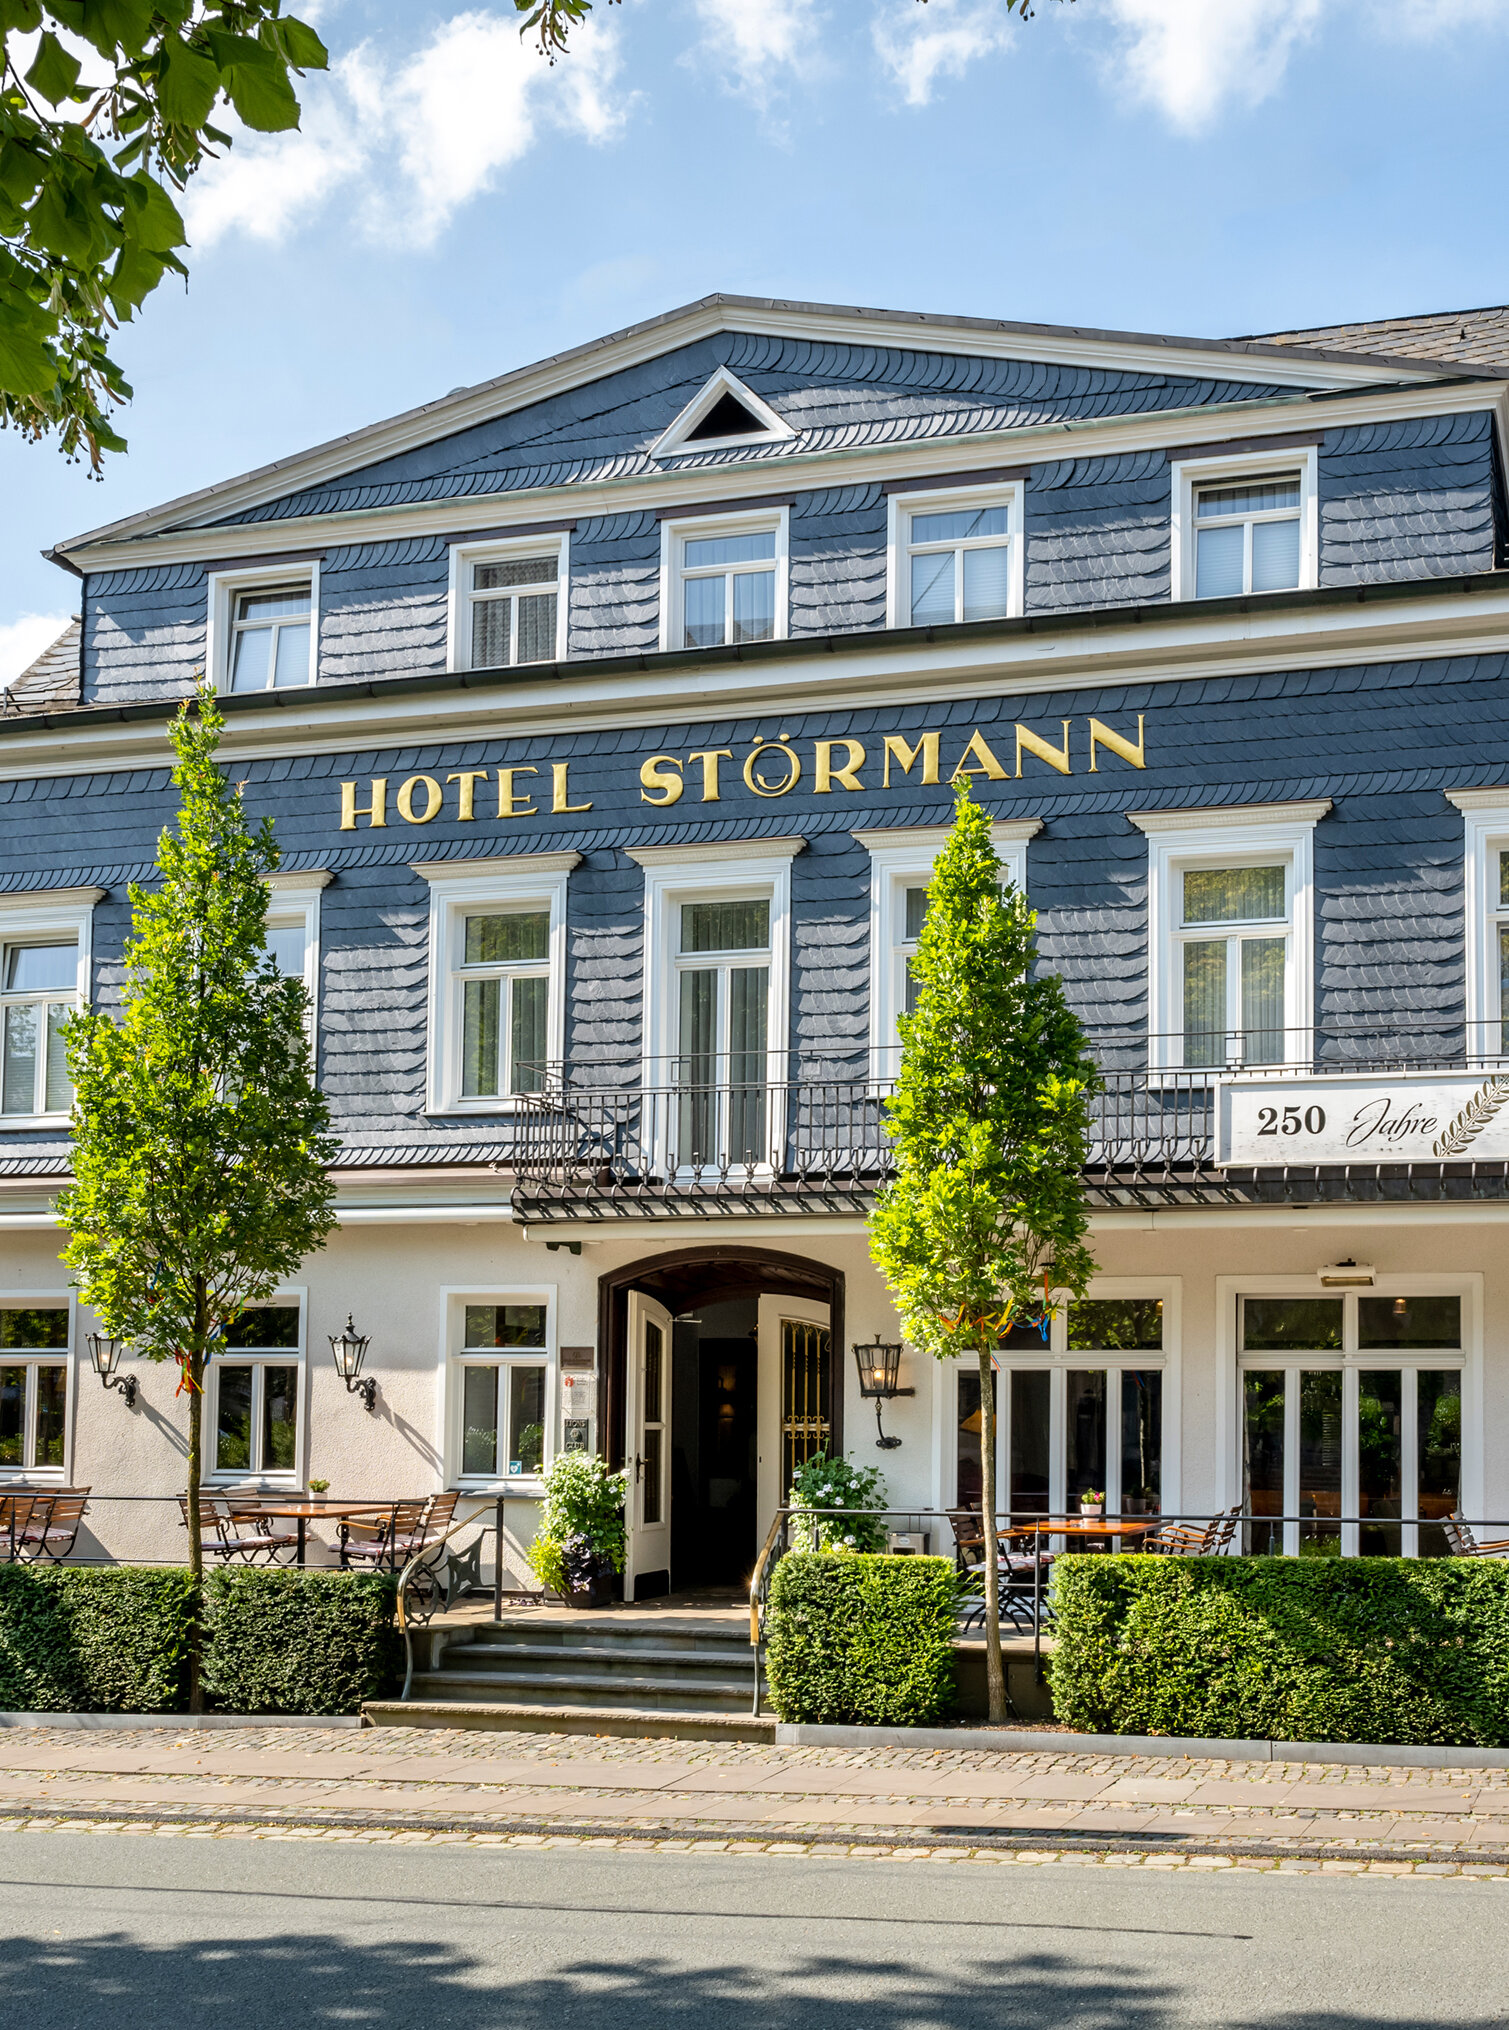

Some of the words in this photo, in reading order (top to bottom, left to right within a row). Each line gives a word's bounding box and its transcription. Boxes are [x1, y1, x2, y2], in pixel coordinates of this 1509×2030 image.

[340, 763, 593, 831] HOTEL
[640, 714, 1146, 806] STÖRMANN
[1257, 1105, 1326, 1136] 250
[1346, 1098, 1438, 1148] Jahre
[565, 1419, 586, 1428] LIONS
[565, 1441, 585, 1450] CLUB
